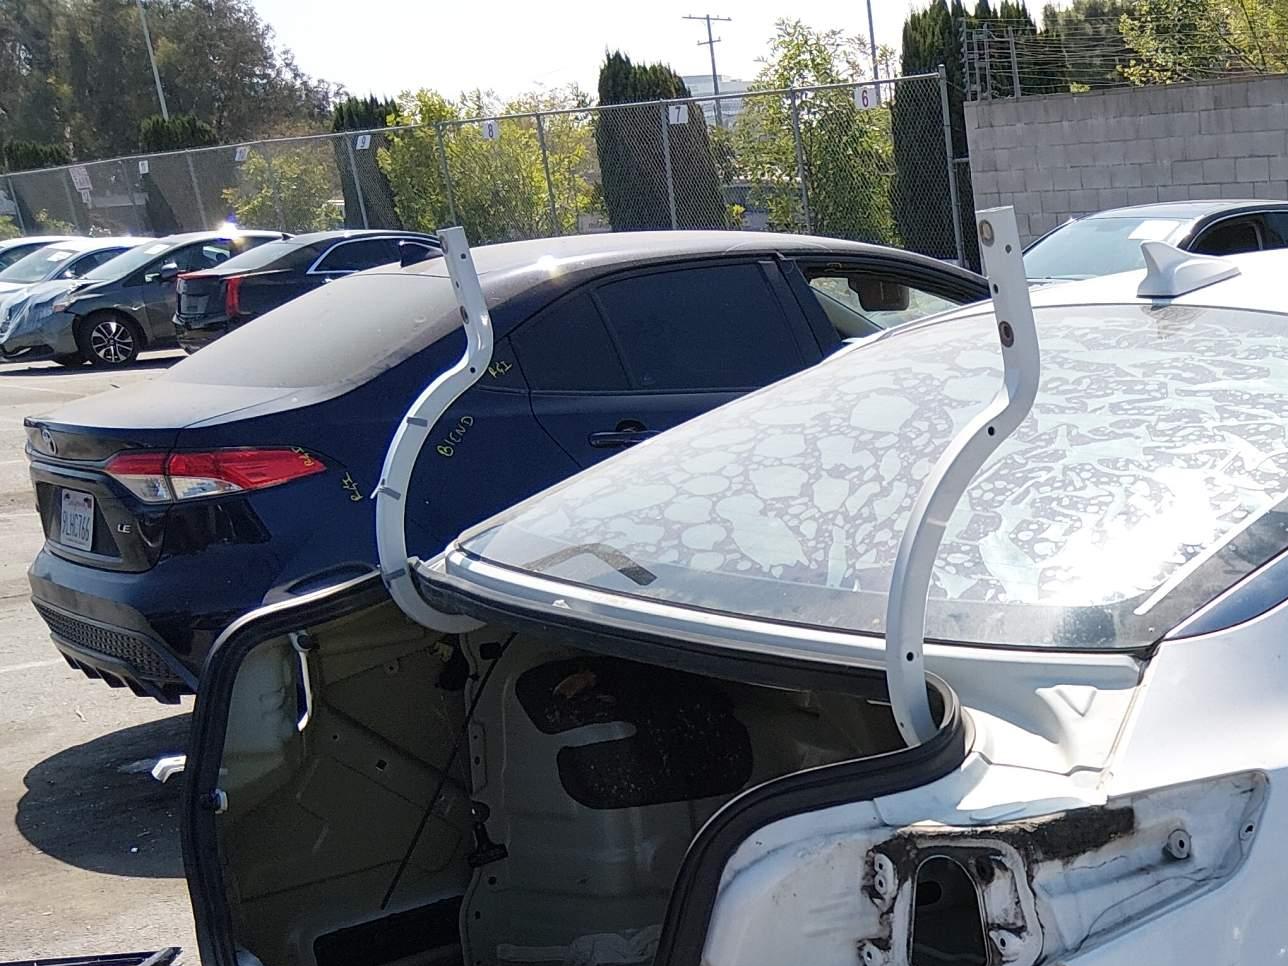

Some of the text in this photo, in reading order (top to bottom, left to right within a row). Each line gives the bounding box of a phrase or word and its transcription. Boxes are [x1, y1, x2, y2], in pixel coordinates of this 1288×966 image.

[861, 90, 869, 108] 6
[674, 106, 682, 122] 7
[487, 123, 494, 138] 8
[360, 136, 368, 148] 9
[117, 523, 131, 534] LE
